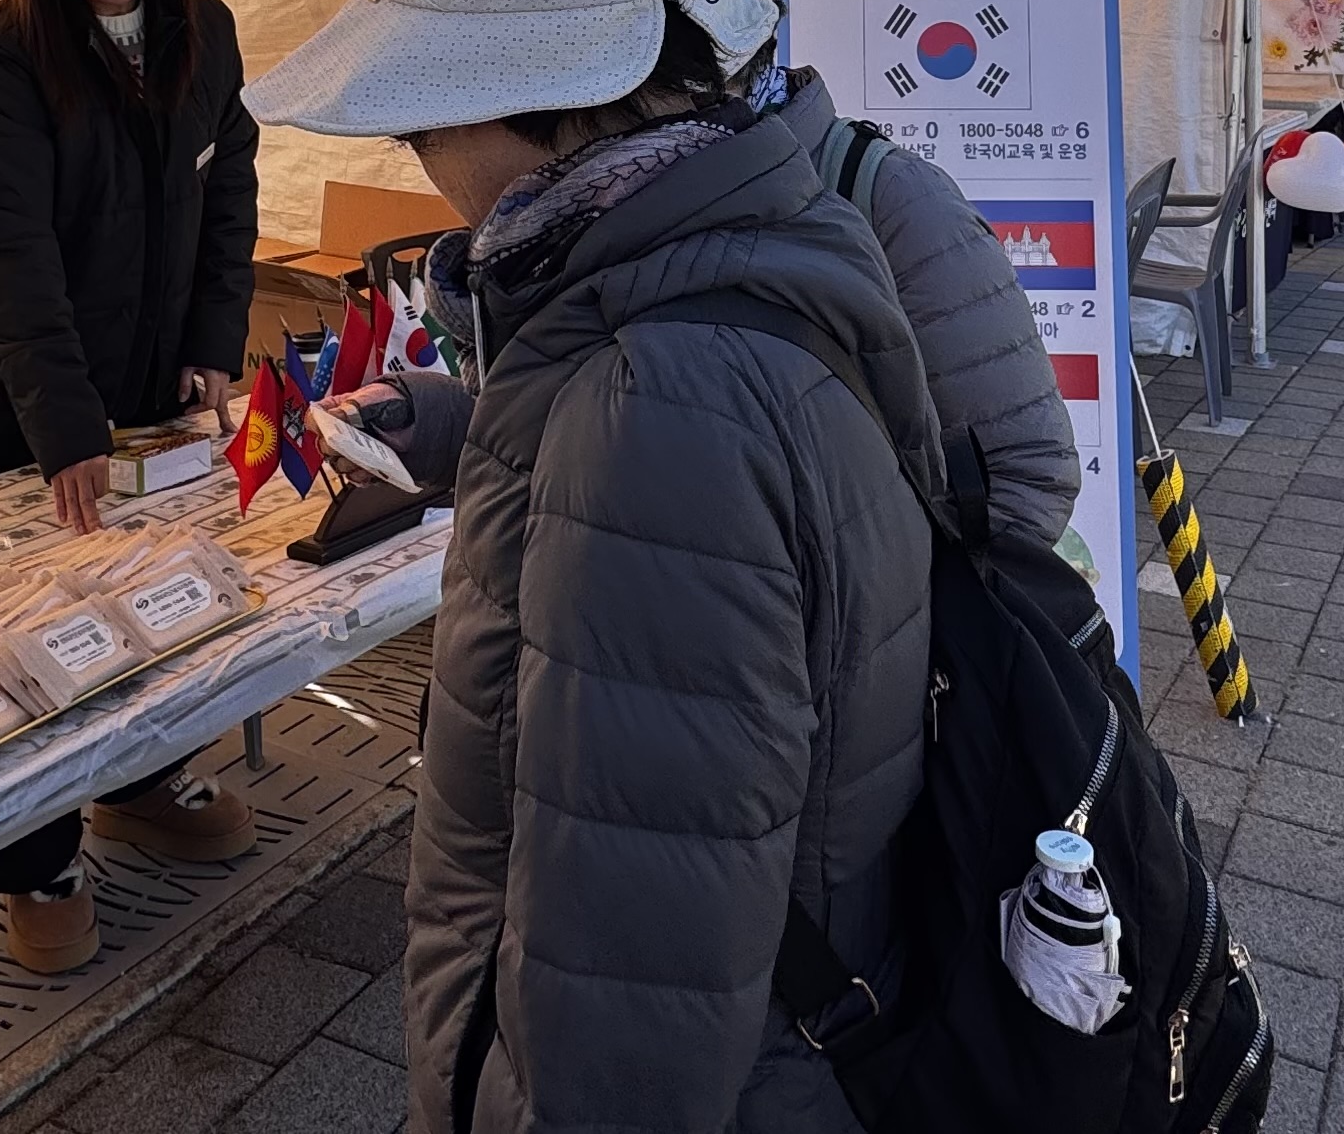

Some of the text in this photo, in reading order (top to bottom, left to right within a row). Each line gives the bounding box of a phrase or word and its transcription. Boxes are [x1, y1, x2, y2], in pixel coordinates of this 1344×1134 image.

[925, 121, 939, 139] 0
[959, 121, 1090, 139] 1800-5048 6
[963, 143, 1087, 160] 한국어교육 및 운영
[1081, 299, 1096, 318] 2
[1086, 457, 1101, 475] 4
